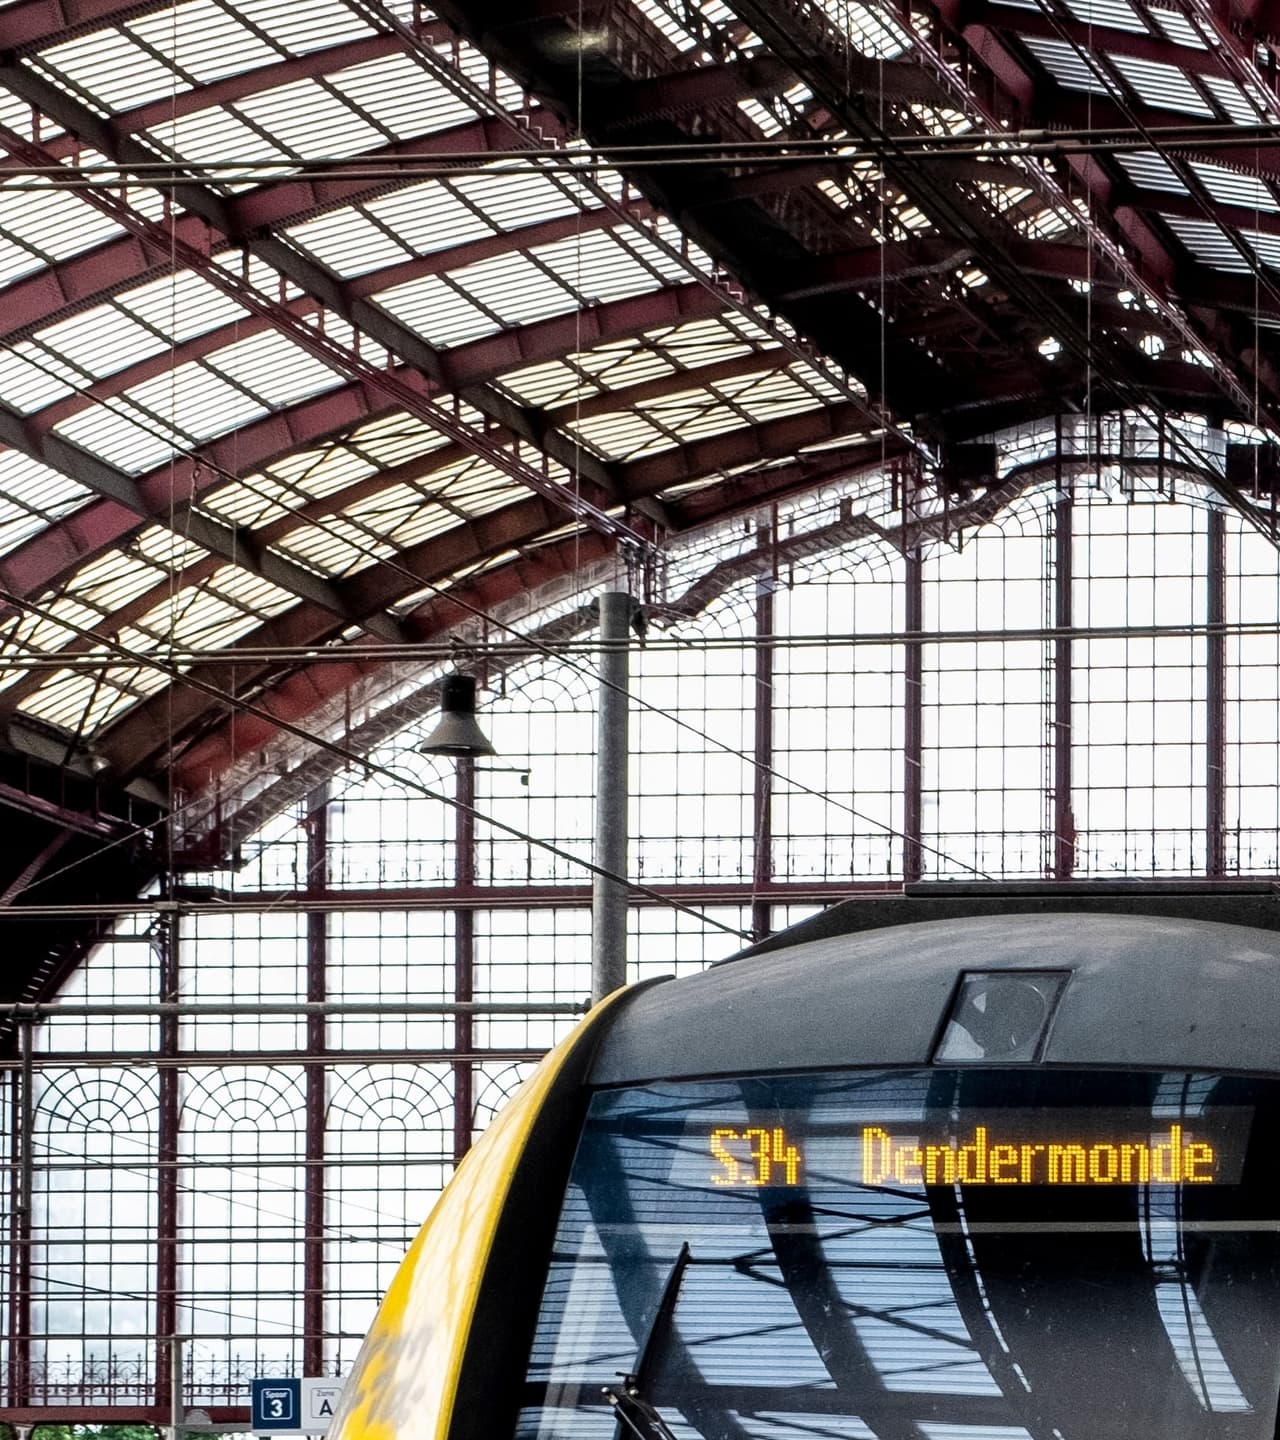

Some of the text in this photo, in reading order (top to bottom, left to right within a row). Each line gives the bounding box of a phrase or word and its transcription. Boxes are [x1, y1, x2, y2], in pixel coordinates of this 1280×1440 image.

[709, 1125, 1214, 1185] S34 Dendermonde
[270, 1399, 283, 1417] 3
[319, 1399, 333, 1416] A
